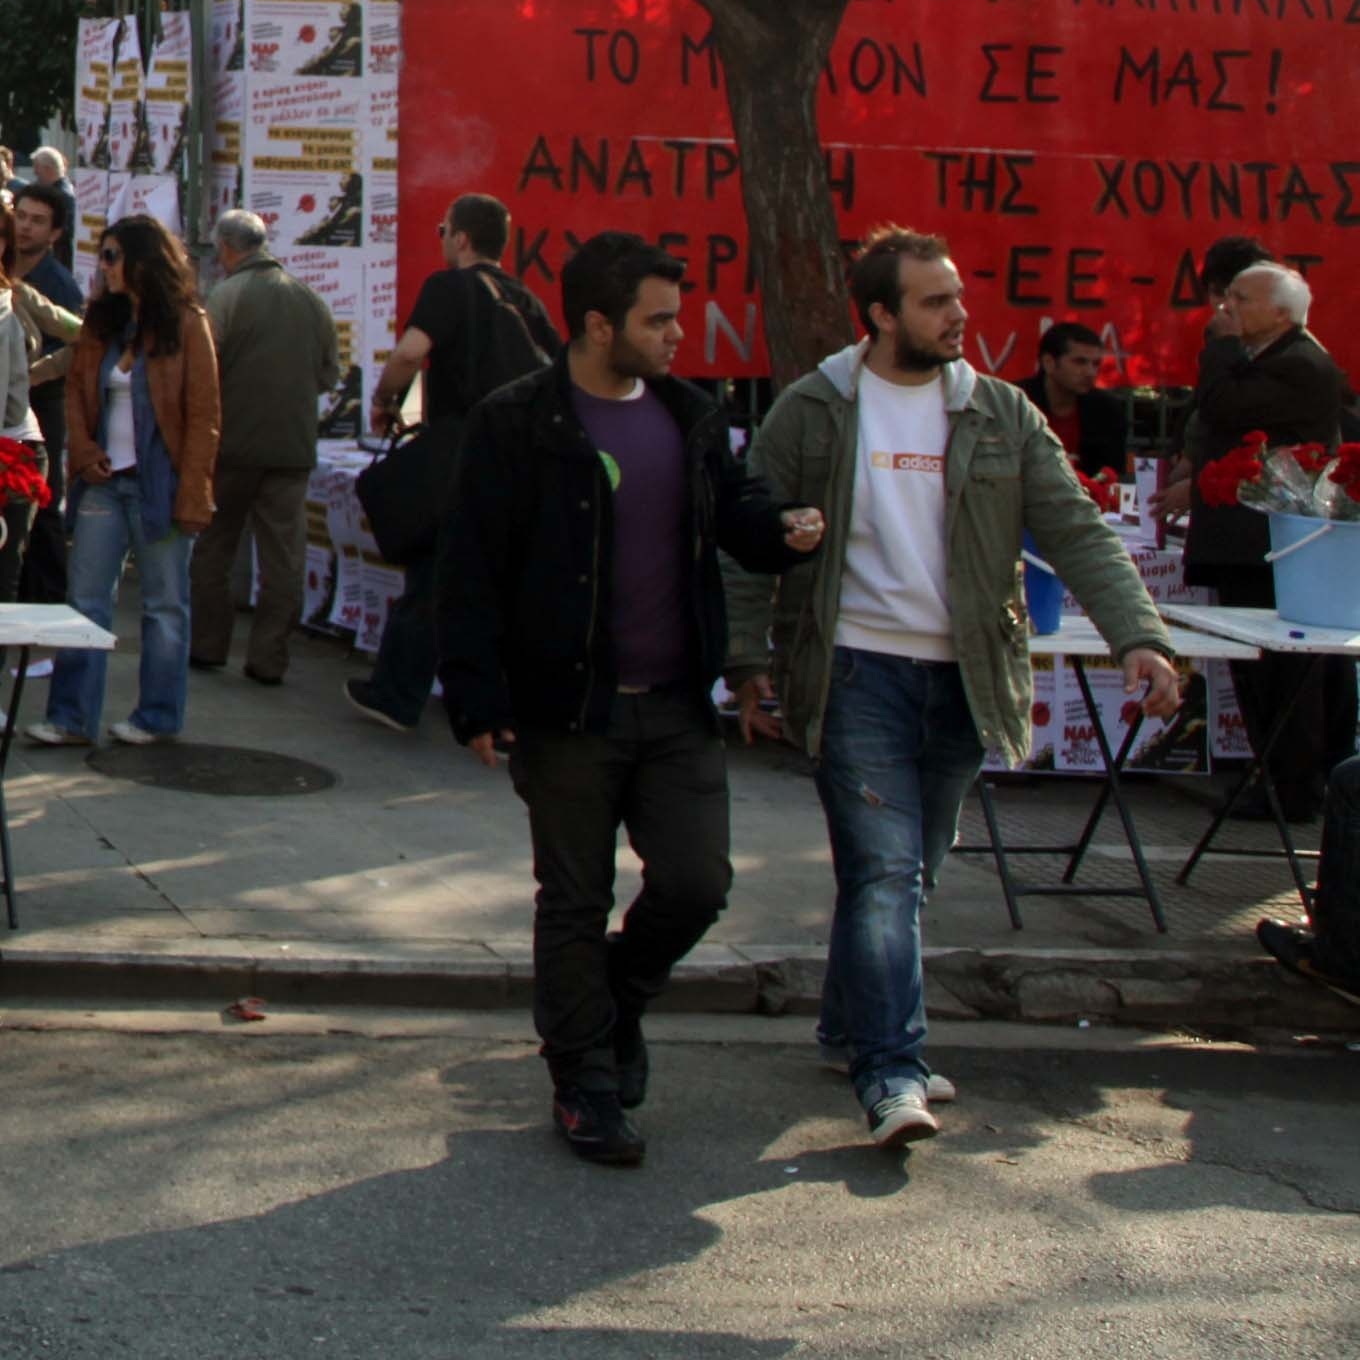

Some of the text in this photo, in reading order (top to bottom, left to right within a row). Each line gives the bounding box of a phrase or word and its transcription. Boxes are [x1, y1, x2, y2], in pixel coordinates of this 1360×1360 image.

[575, 28, 1283, 116] ΤΟ ΜΛΟΝ ΣΕ ΜΑΣ!
[519, 135, 1360, 227] ΑΝΑΤΡΗ ΤΗΣ ΧΟΥΝΤΑΣ
